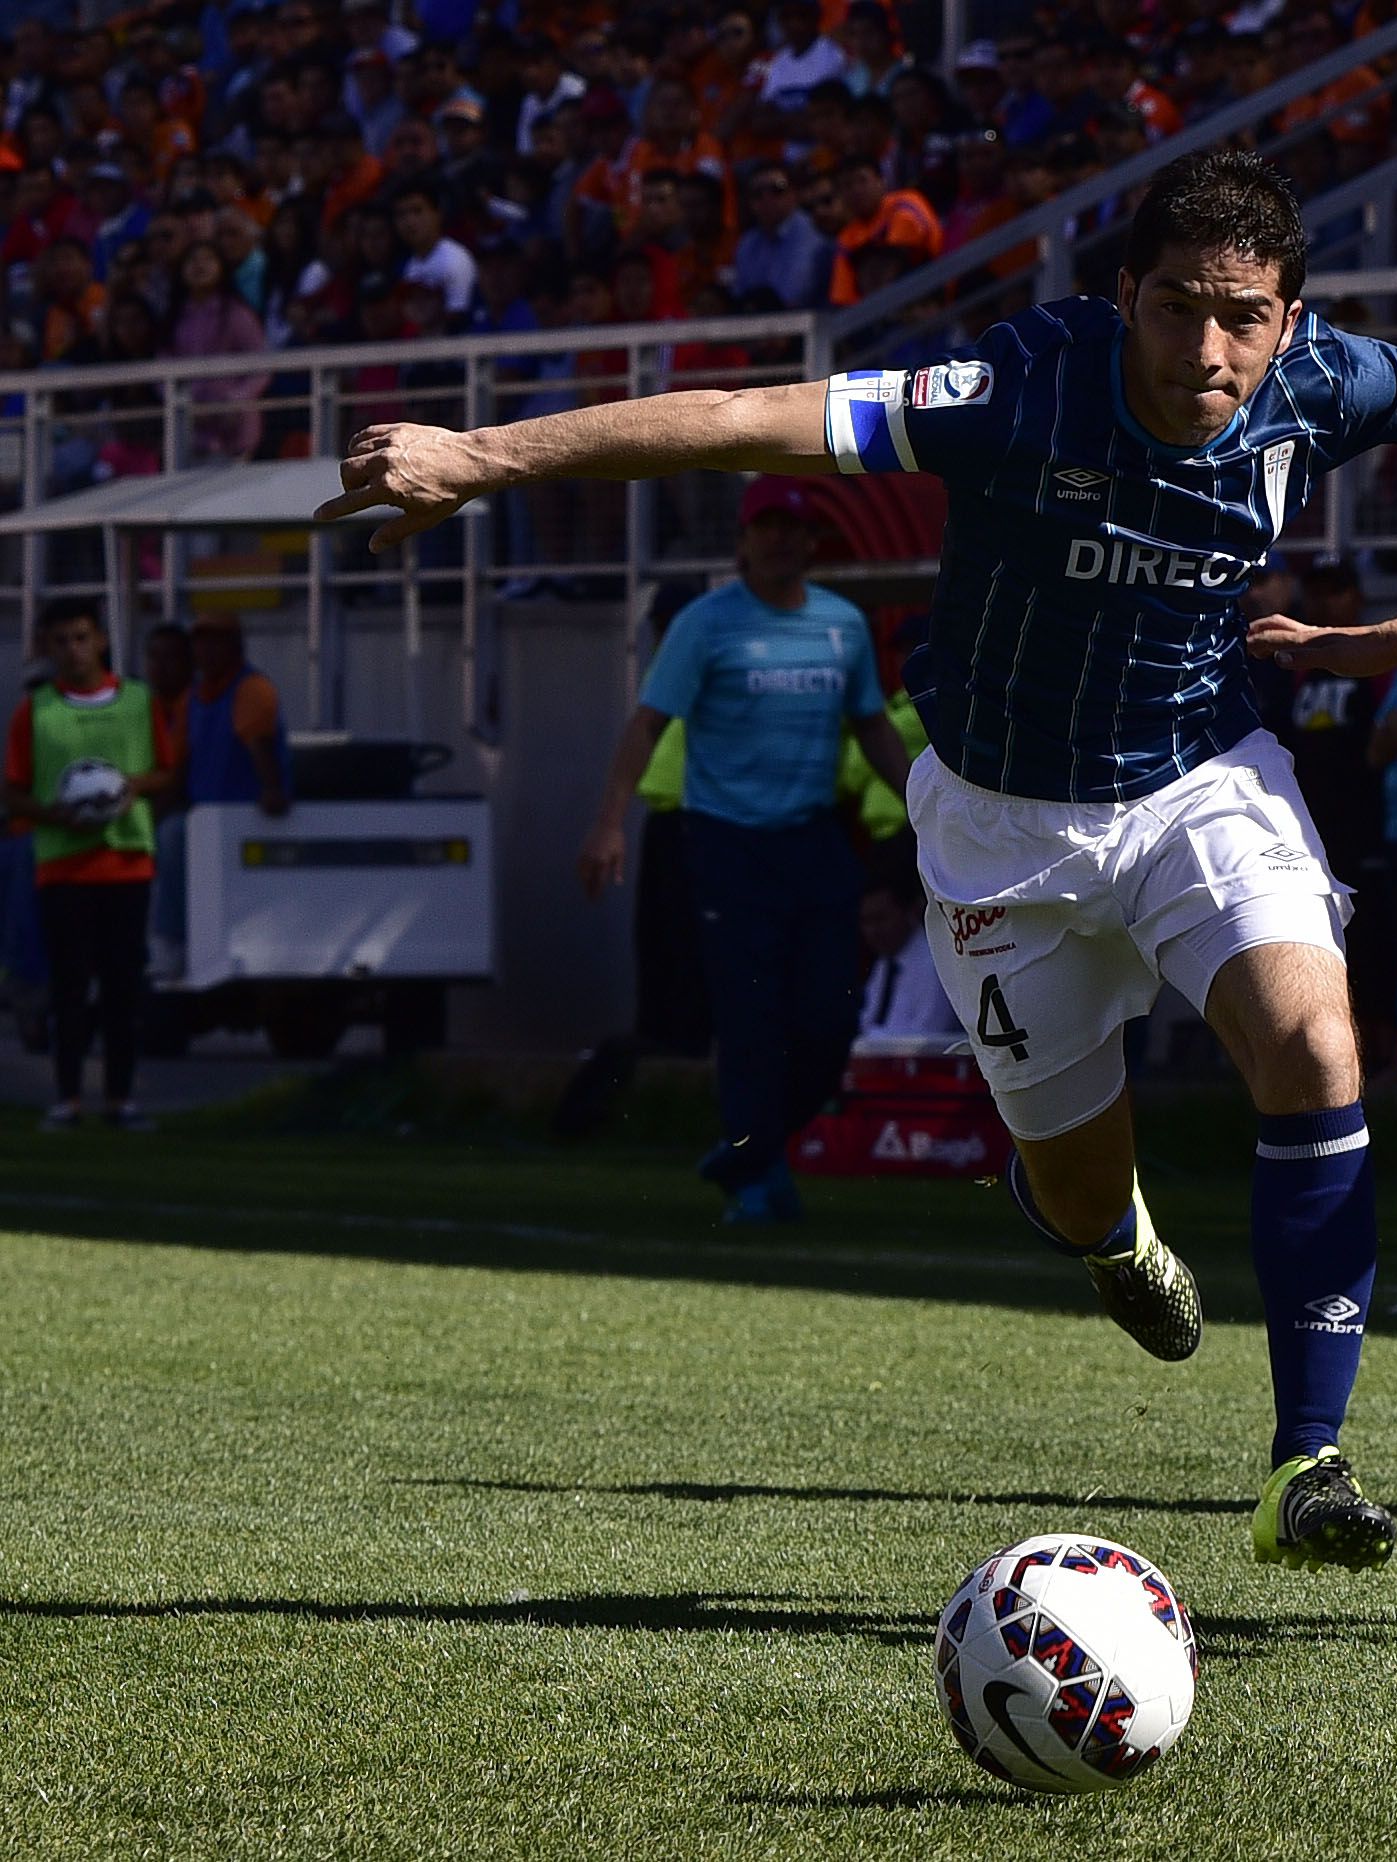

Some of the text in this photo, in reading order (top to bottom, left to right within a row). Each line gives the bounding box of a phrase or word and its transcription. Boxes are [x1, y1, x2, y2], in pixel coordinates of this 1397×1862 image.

[1056, 488, 1101, 500] umbro
[976, 973, 1028, 1062] 4
[1294, 1319, 1363, 1335] umbro
